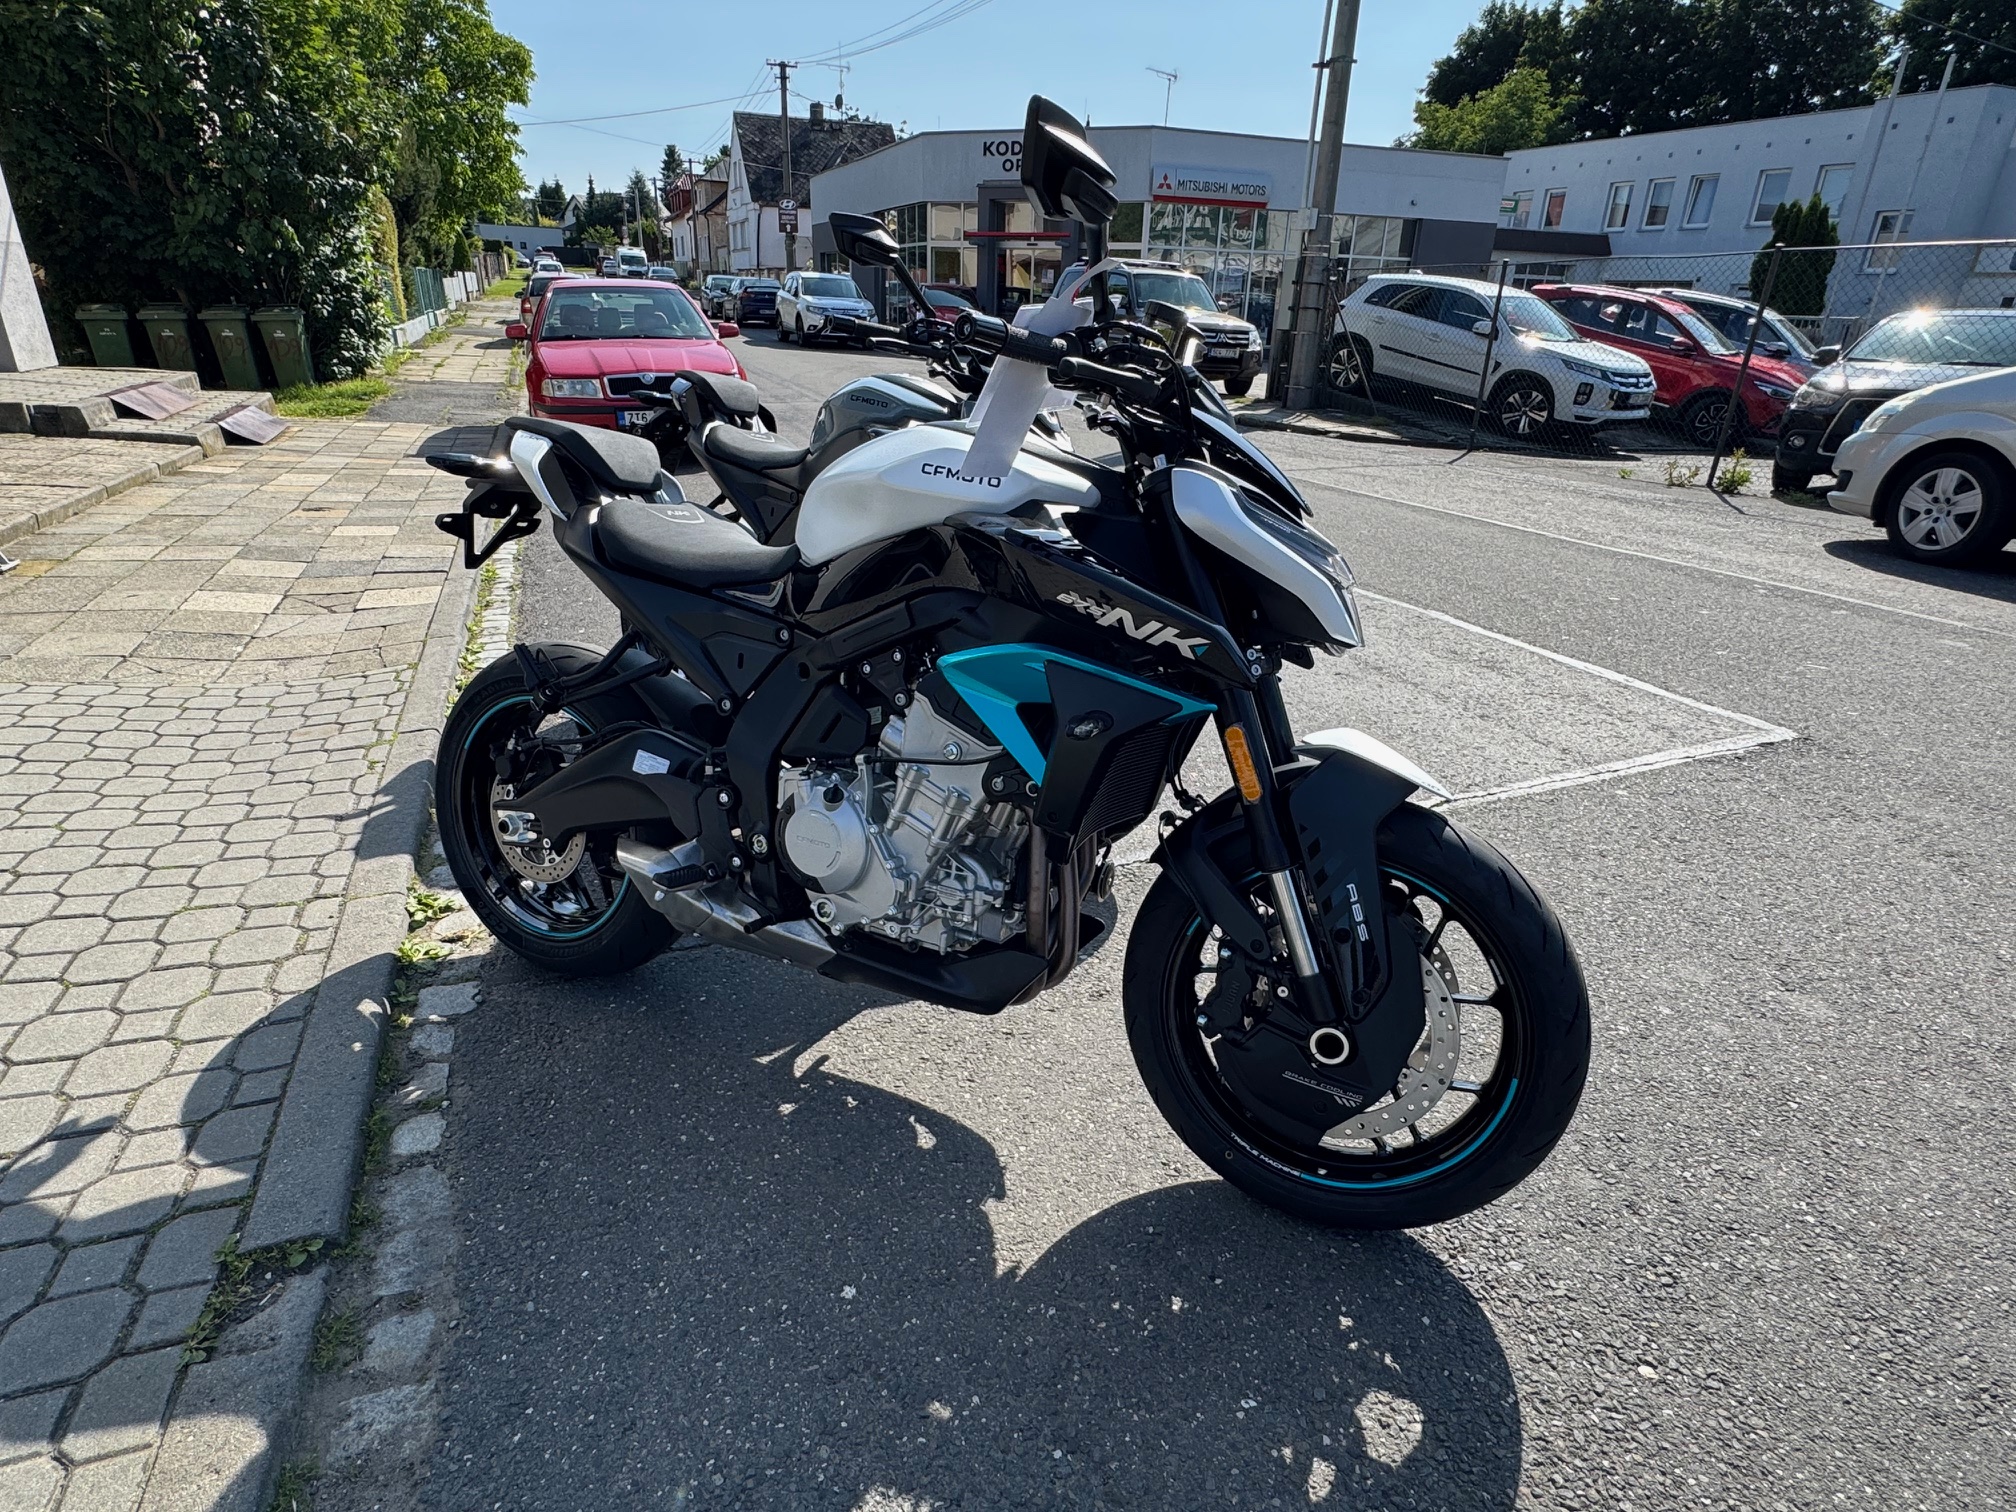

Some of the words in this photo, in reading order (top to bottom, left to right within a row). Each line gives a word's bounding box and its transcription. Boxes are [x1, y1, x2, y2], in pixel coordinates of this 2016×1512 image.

[1177, 179, 1228, 194] MITSUBISHI
[1231, 183, 1267, 196] MOTORS
[850, 394, 889, 408] CFMOTO
[627, 412, 648, 424] 7T6
[1095, 606, 1212, 661] NK
[796, 835, 830, 849] CFMOTO
[1346, 883, 1369, 942] ABS
[1284, 1070, 1318, 1085] BRAKE
[1320, 1083, 1363, 1100] COOLING
[1230, 1131, 1260, 1156] TRIPLE
